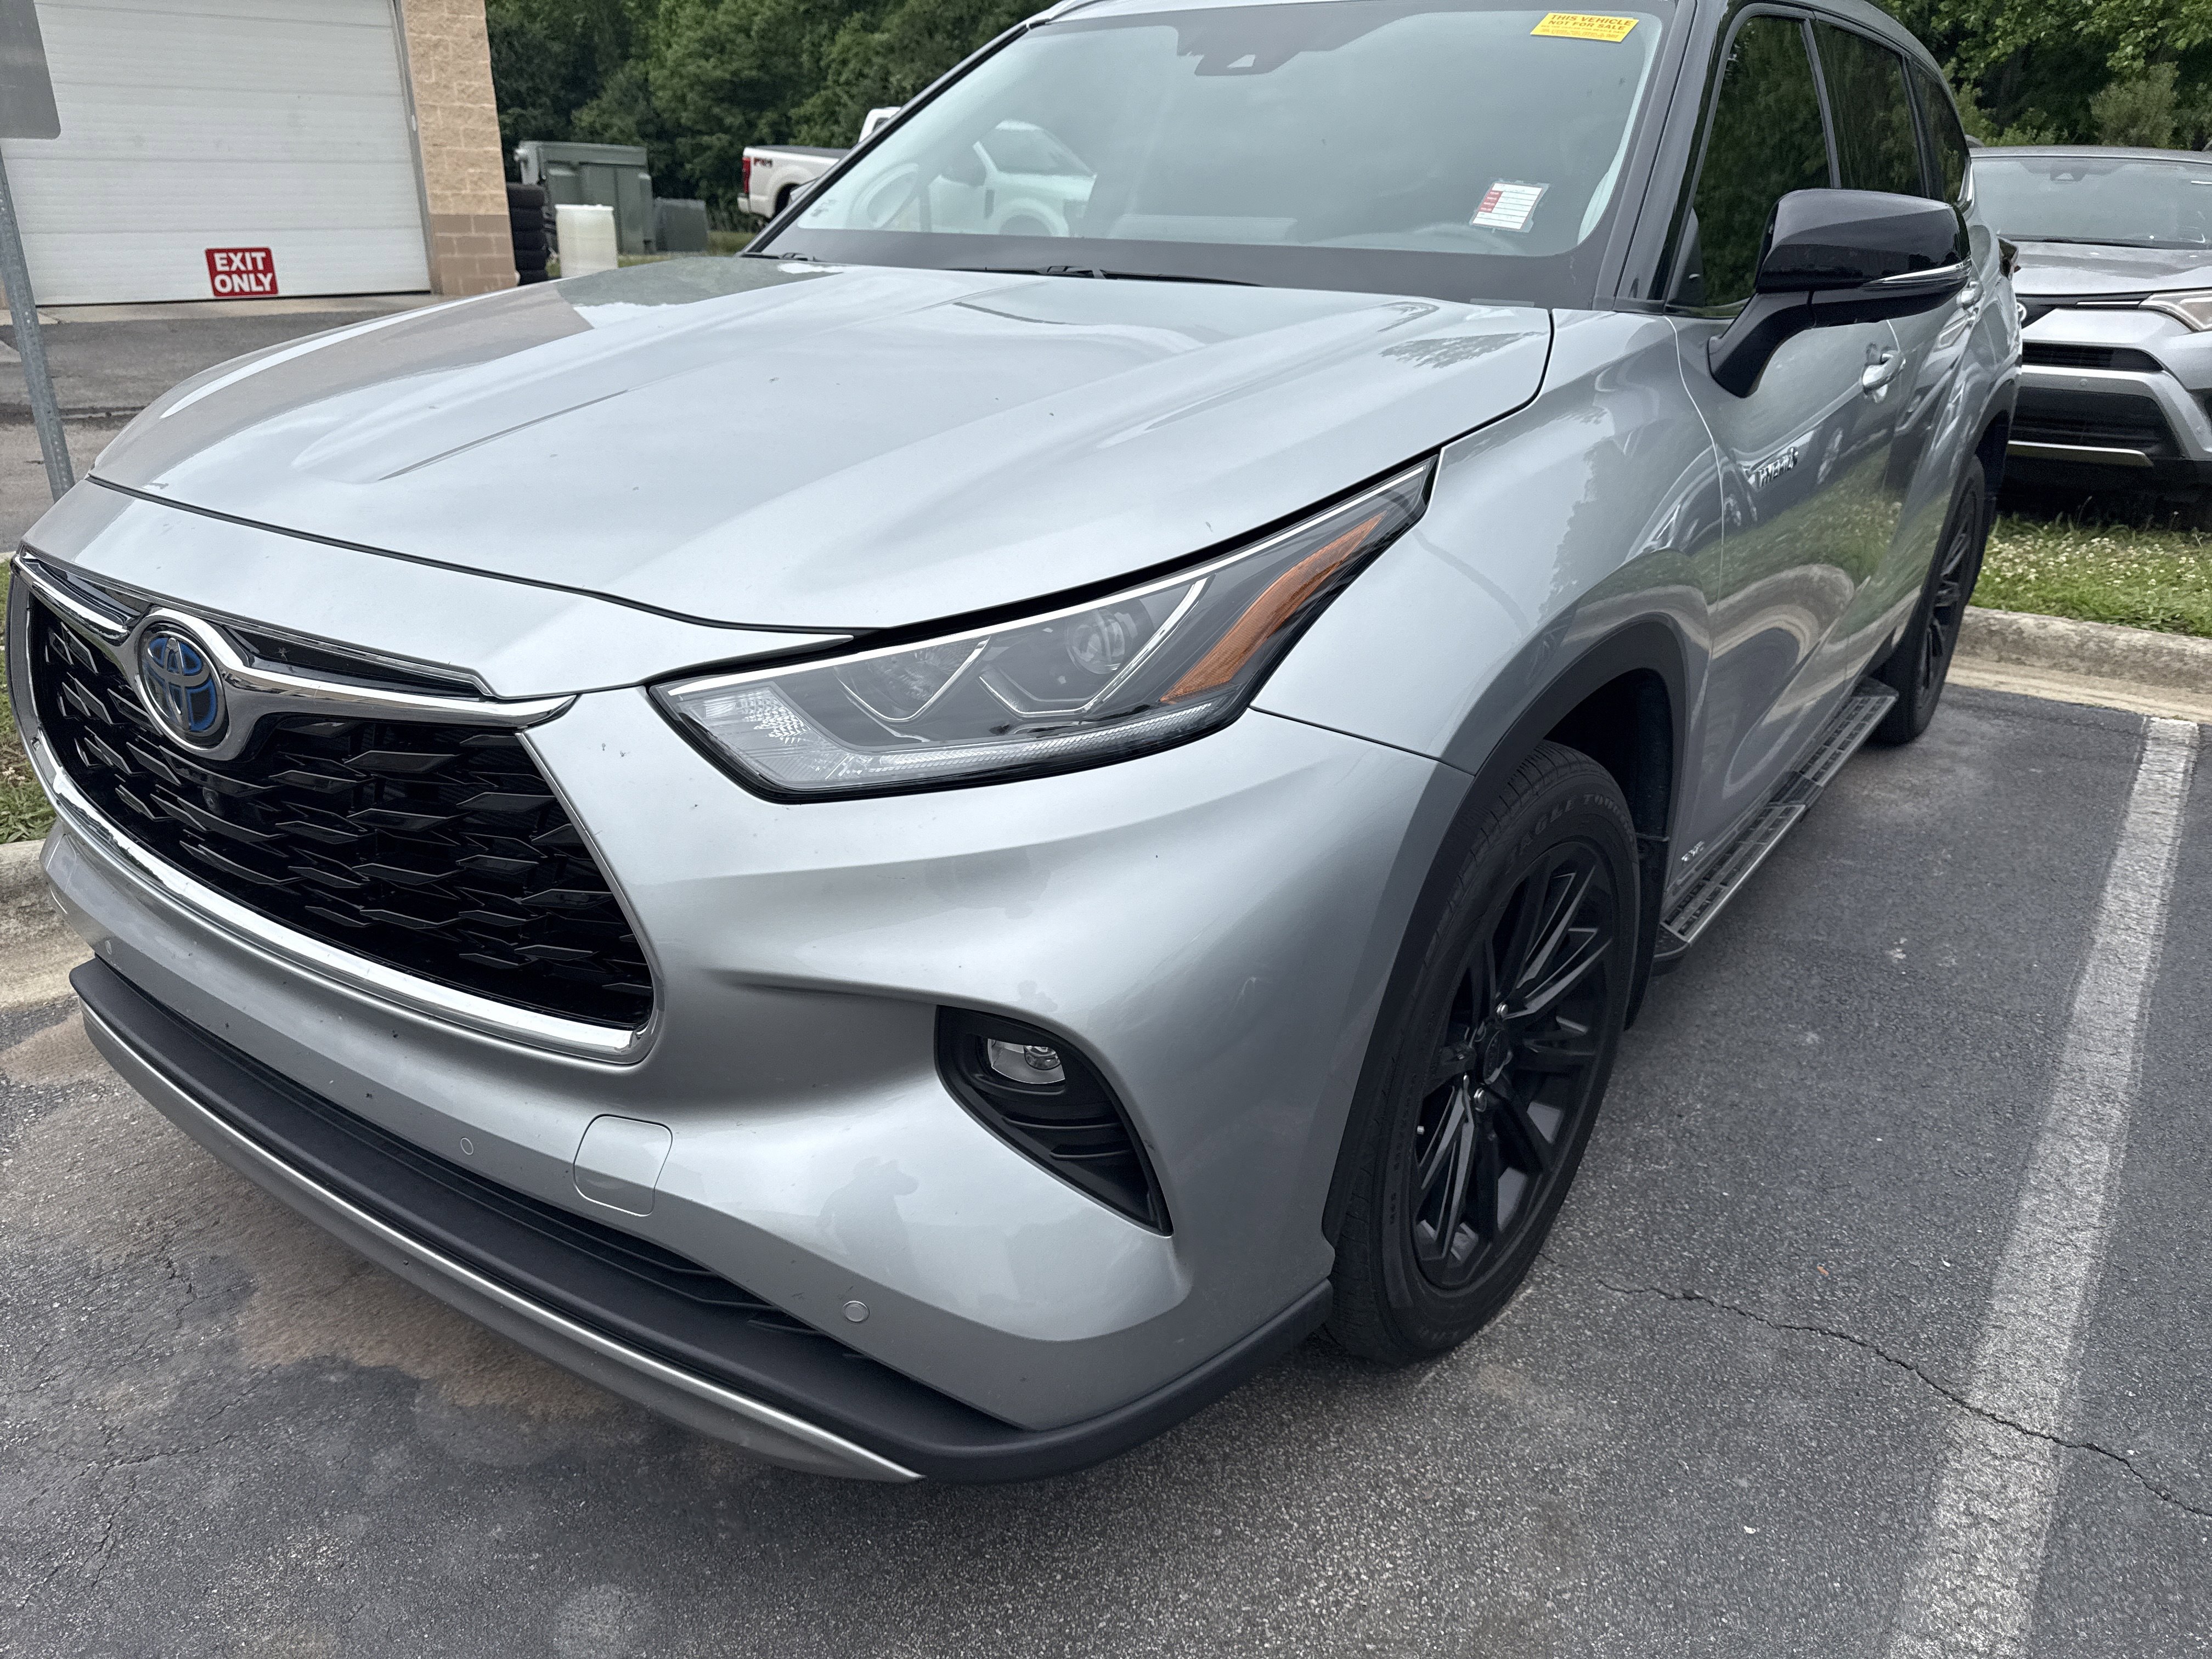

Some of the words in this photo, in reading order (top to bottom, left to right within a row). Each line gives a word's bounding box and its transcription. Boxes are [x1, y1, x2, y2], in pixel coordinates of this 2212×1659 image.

[1582, 16, 1633, 26] VEHICLE
[213, 251, 266, 272] EXIT
[215, 273, 273, 293] ONLY
